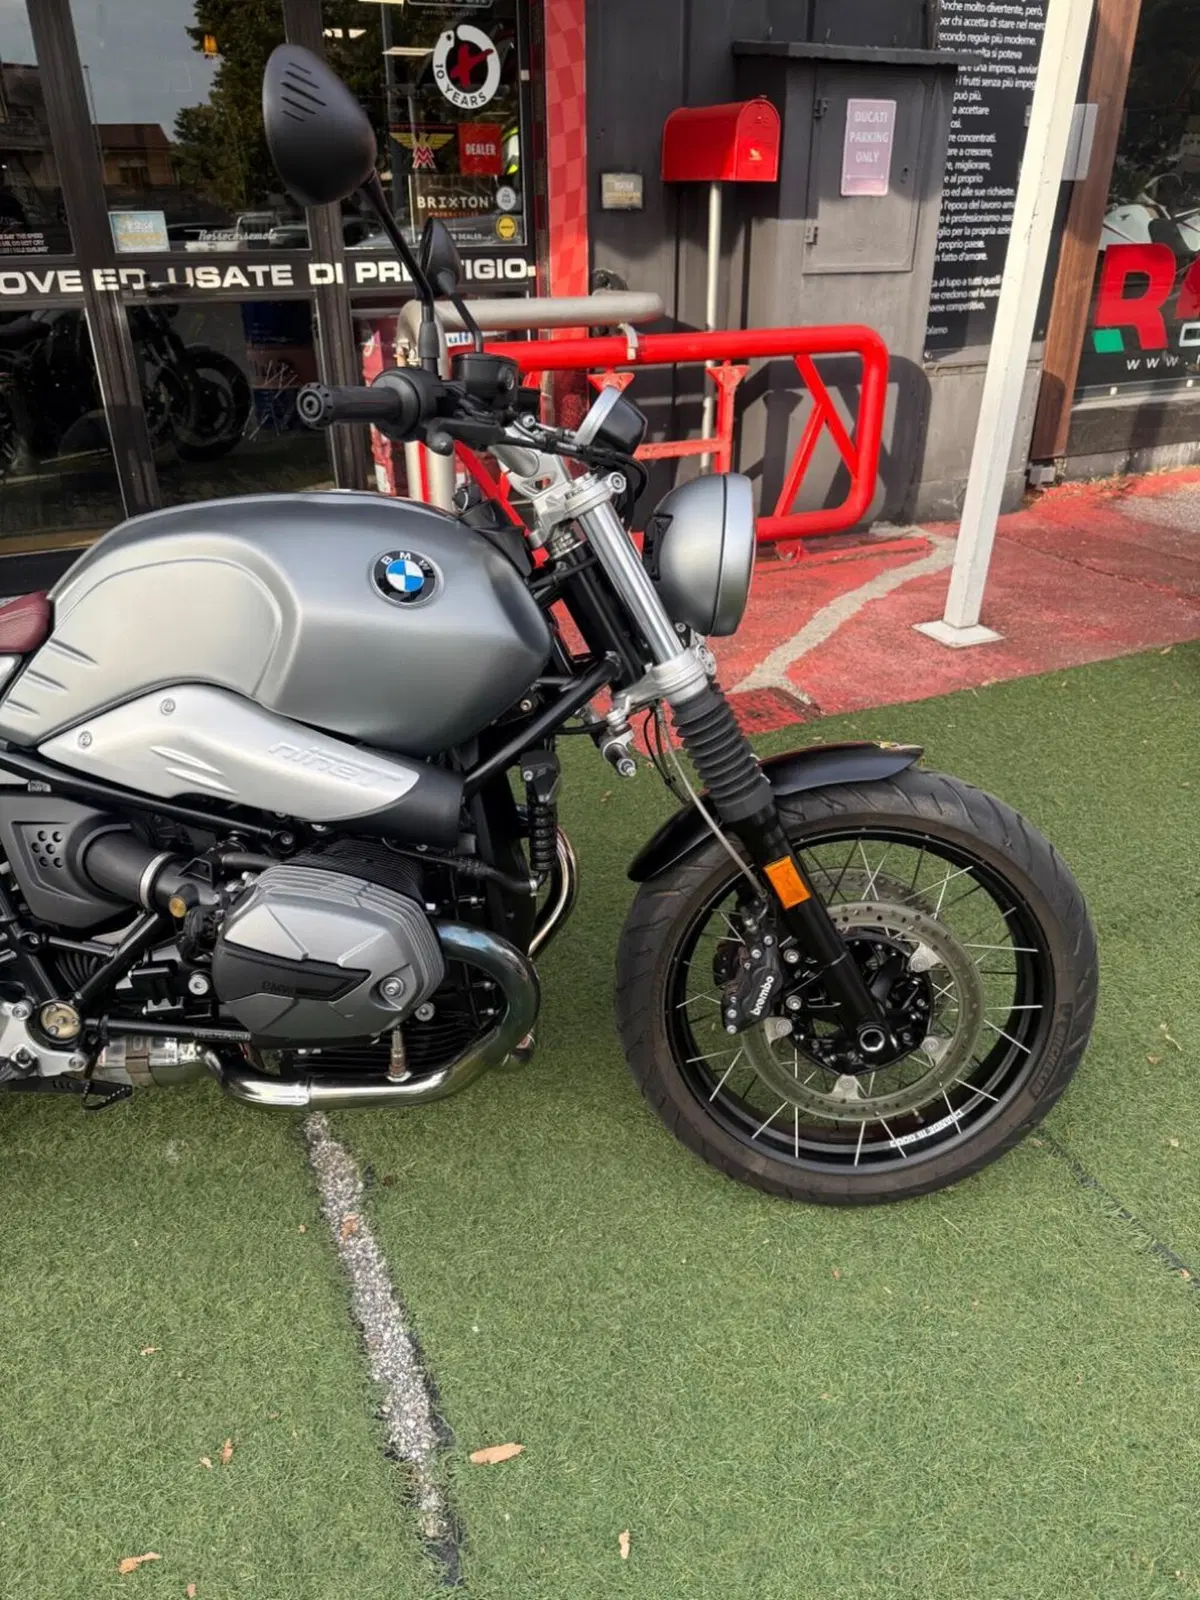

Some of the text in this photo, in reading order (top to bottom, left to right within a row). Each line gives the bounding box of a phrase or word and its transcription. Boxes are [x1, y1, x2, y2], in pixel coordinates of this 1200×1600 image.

[964, 1, 986, 13] molto
[986, 2, 1024, 16] divertente,
[1025, 5, 1044, 17] però,
[951, 15, 963, 26] chi
[963, 17, 989, 28] accetta
[989, 17, 997, 28] di
[998, 19, 1016, 29] stare
[1016, 18, 1028, 30] nel
[967, 32, 990, 46] regole
[991, 33, 1004, 47] più
[1004, 33, 1037, 46] moderne.
[998, 49, 1023, 61] poteva
[988, 62, 1017, 75] impresa,
[962, 75, 981, 87] frutti
[981, 77, 1002, 88] senza
[1002, 76, 1014, 90] più
[445, 83, 488, 107] YEARS
[953, 90, 983, 103] può più.
[854, 110, 889, 124] DUCATI
[958, 105, 990, 116] accettare
[849, 130, 890, 144] PARKING
[957, 132, 997, 143] concentrati.
[465, 143, 496, 157] DEALER
[855, 150, 881, 164] ONLY
[964, 147, 993, 158] crescere,
[954, 159, 991, 173] migliorare,
[950, 172, 957, 183] al
[957, 172, 984, 185] proprio
[951, 186, 960, 197] ed
[960, 186, 974, 197] alle
[974, 188, 986, 197] sue
[986, 185, 1015, 197] richieste.
[417, 196, 489, 209] BRIXTON
[968, 199, 980, 210] del
[980, 199, 1002, 210] lavoro
[951, 211, 1000, 226] professionismo
[951, 227, 963, 239] per
[963, 225, 971, 236] la
[971, 225, 997, 238] propria
[938, 239, 986, 251] proprio paese.
[941, 252, 958, 263] fatto
[958, 252, 988, 263] d'amore.
[0, 270, 84, 294] OVE
[166, 263, 295, 289] USATE
[308, 262, 344, 285] DI
[355, 257, 536, 285] PRIGIO.
[938, 278, 945, 288] al
[946, 277, 961, 289] lupo
[967, 275, 983, 287] tutti
[982, 273, 1001, 287] quelli
[940, 289, 968, 300] credono
[968, 287, 979, 299] nel
[1094, 243, 1200, 350] R
[946, 301, 986, 314] competitivo.
[1126, 353, 1200, 371] www.
[380, 551, 431, 571] BMW
